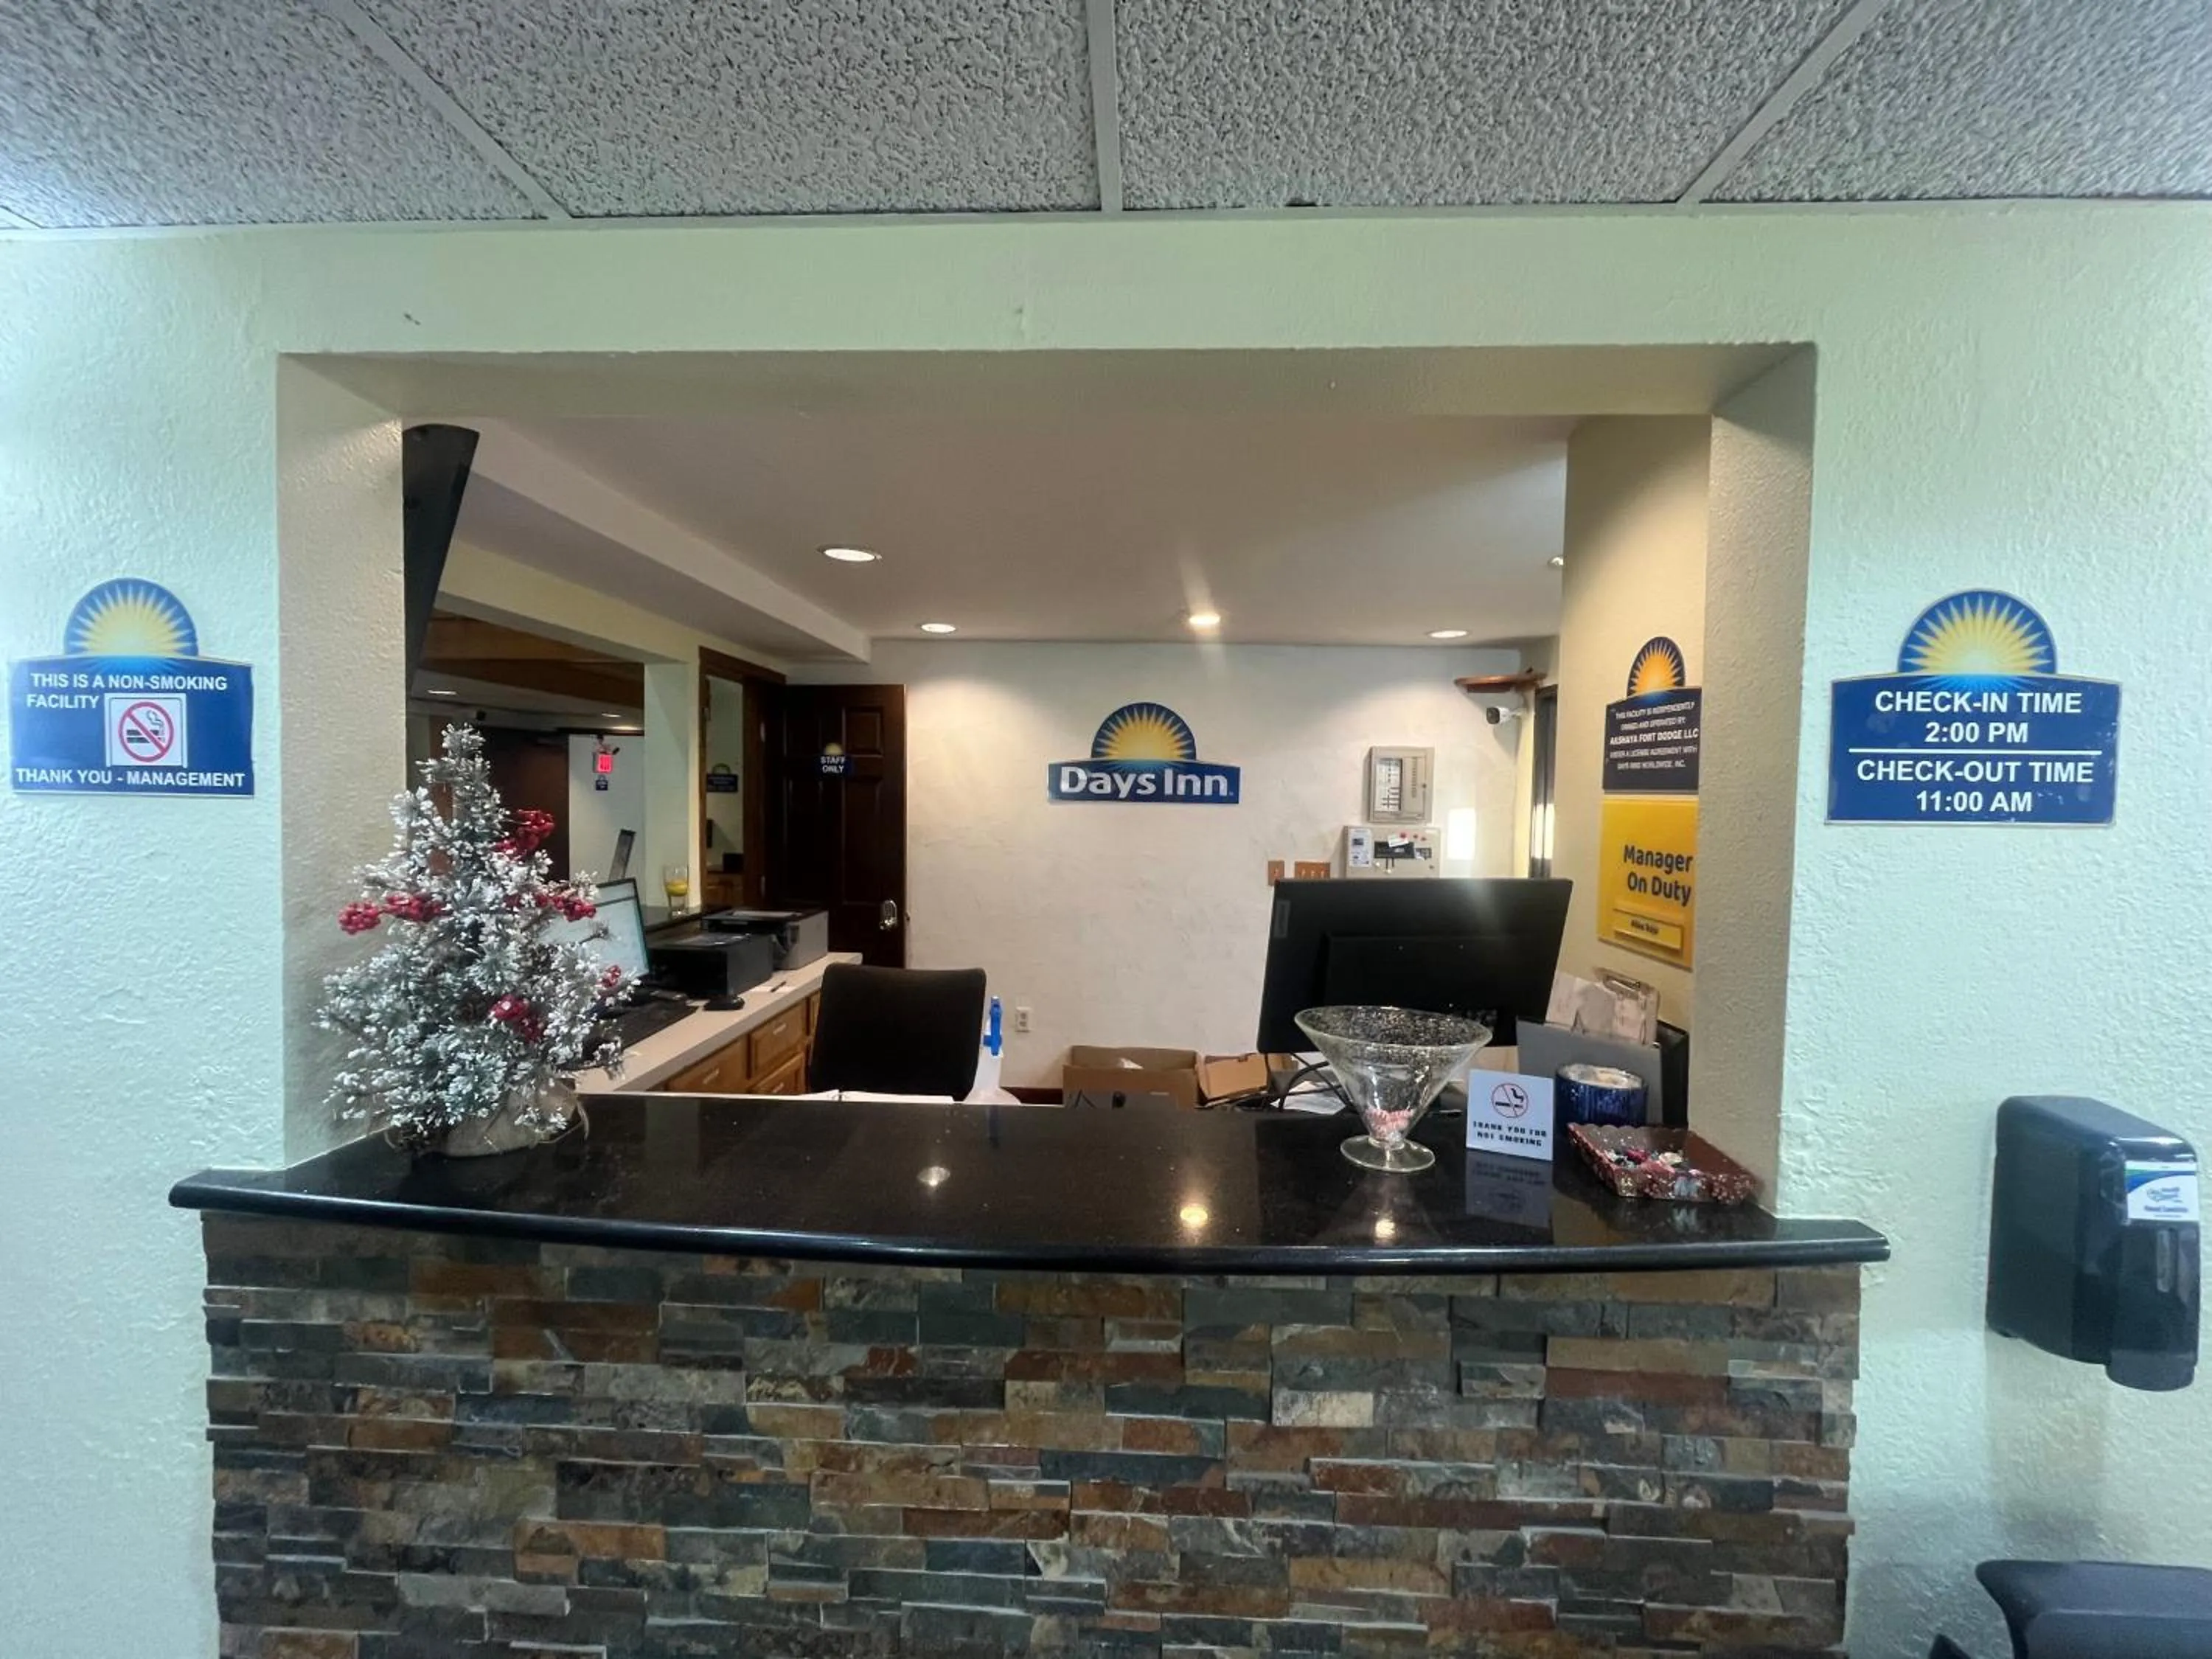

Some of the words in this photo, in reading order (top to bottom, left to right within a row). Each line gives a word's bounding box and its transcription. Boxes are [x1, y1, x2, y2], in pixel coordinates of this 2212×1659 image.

[31, 673, 69, 688] THIS
[74, 674, 88, 688] IS
[92, 675, 105, 688] A
[108, 675, 228, 689] NON-SMOKING
[27, 695, 100, 709] FACILITY
[1875, 691, 2008, 713] CHECK-IN
[2017, 692, 2081, 713] TIME
[1683, 728, 1699, 738] LLC
[1924, 722, 1979, 742] 2:00
[1989, 723, 2028, 743] PM
[821, 756, 846, 764] STAFF
[822, 765, 844, 773] ONLY
[15, 768, 72, 784] THANK
[77, 769, 111, 784] YOU
[127, 771, 245, 787] MANAGEMENT
[1857, 759, 2021, 782] CHECK-OUT
[2030, 762, 2094, 783] TIME
[1060, 766, 1156, 799] Days
[1164, 768, 1228, 796] Inn
[1916, 790, 1983, 812] 11:00
[1990, 792, 2032, 812] AM
[1624, 844, 1693, 874] Manager
[1627, 872, 1646, 894] On
[1651, 876, 1691, 907] Duty
[1473, 1120, 1502, 1130] THANK
[1508, 1126, 1526, 1135] YOU
[1529, 1129, 1547, 1137] FOR
[1477, 1131, 1494, 1139] NOT
[1499, 1134, 1542, 1147] SMOKING
